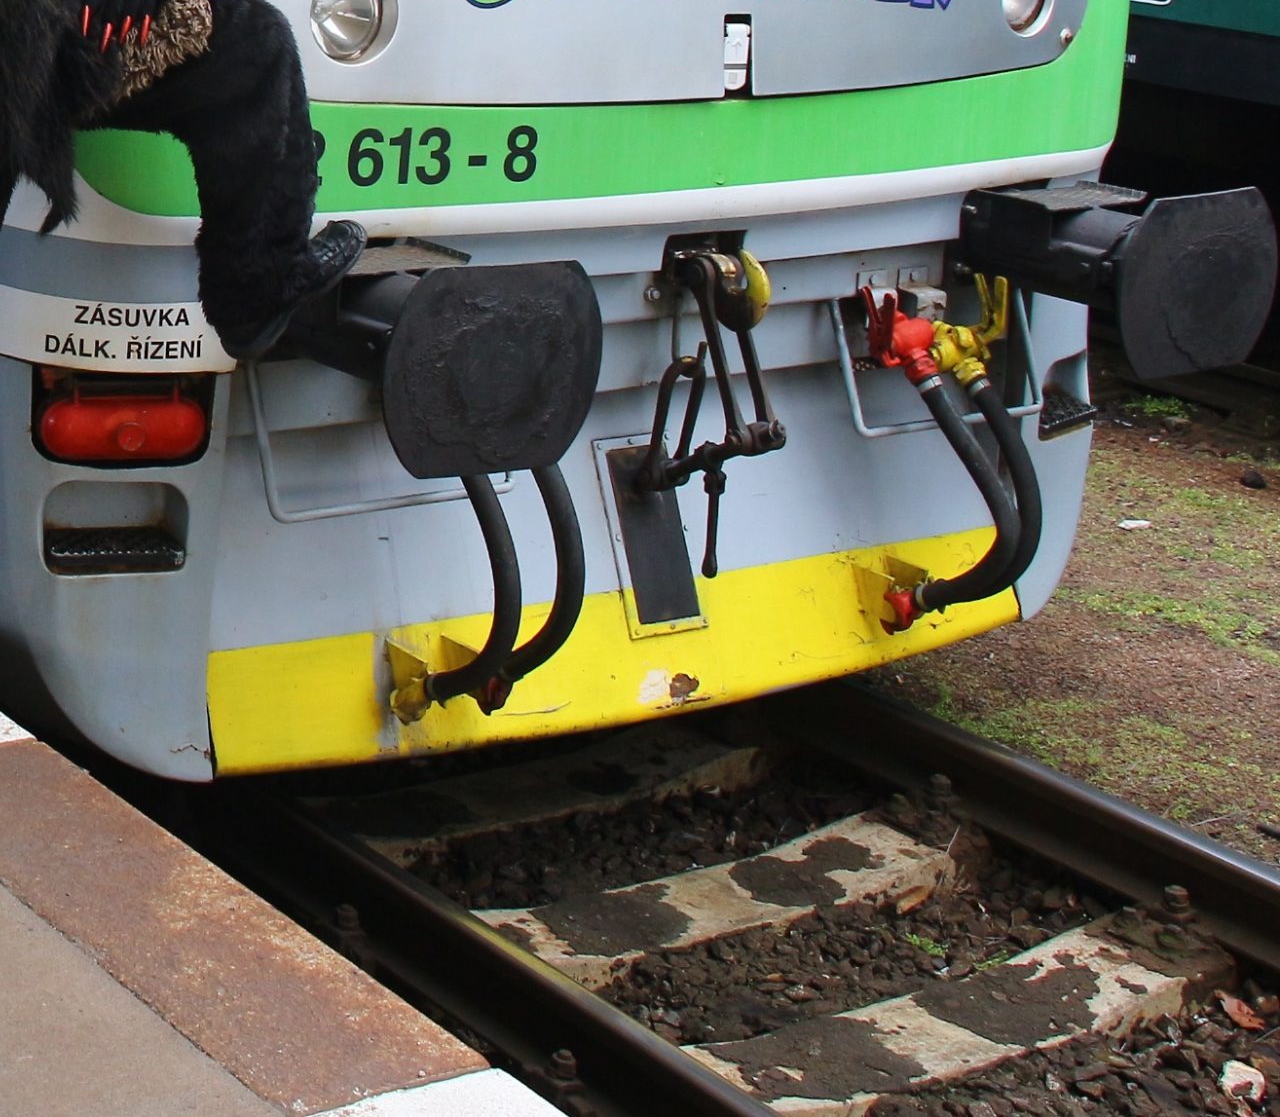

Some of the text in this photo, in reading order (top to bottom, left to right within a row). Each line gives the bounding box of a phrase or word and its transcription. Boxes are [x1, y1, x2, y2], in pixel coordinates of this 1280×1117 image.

[347, 126, 452, 188] 613
[503, 124, 539, 183] 8
[74, 303, 190, 327] ZÁSUVKA
[44, 333, 203, 360] DÁLK. ŘÍZENÍ
